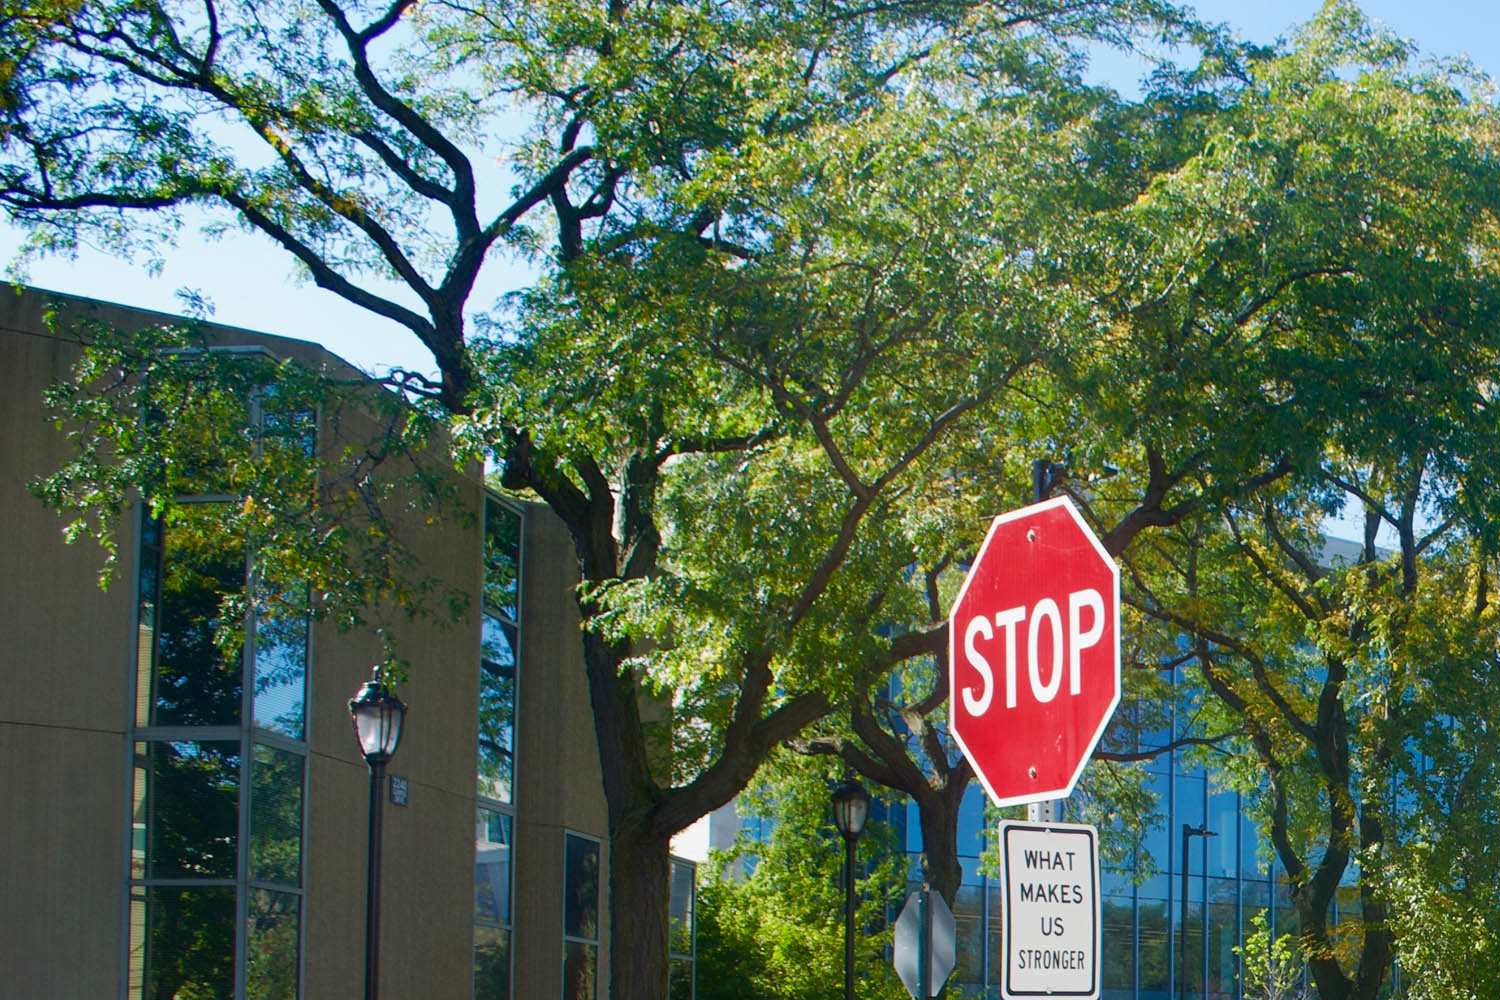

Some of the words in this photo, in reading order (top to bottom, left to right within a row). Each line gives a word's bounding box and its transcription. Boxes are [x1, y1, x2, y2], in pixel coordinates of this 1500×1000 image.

[962, 588, 1106, 718] STOP
[1024, 849, 1075, 871] WHAT
[1020, 882, 1084, 904] MAKES
[1041, 916, 1065, 937] US
[1018, 949, 1086, 971] STRONGER
